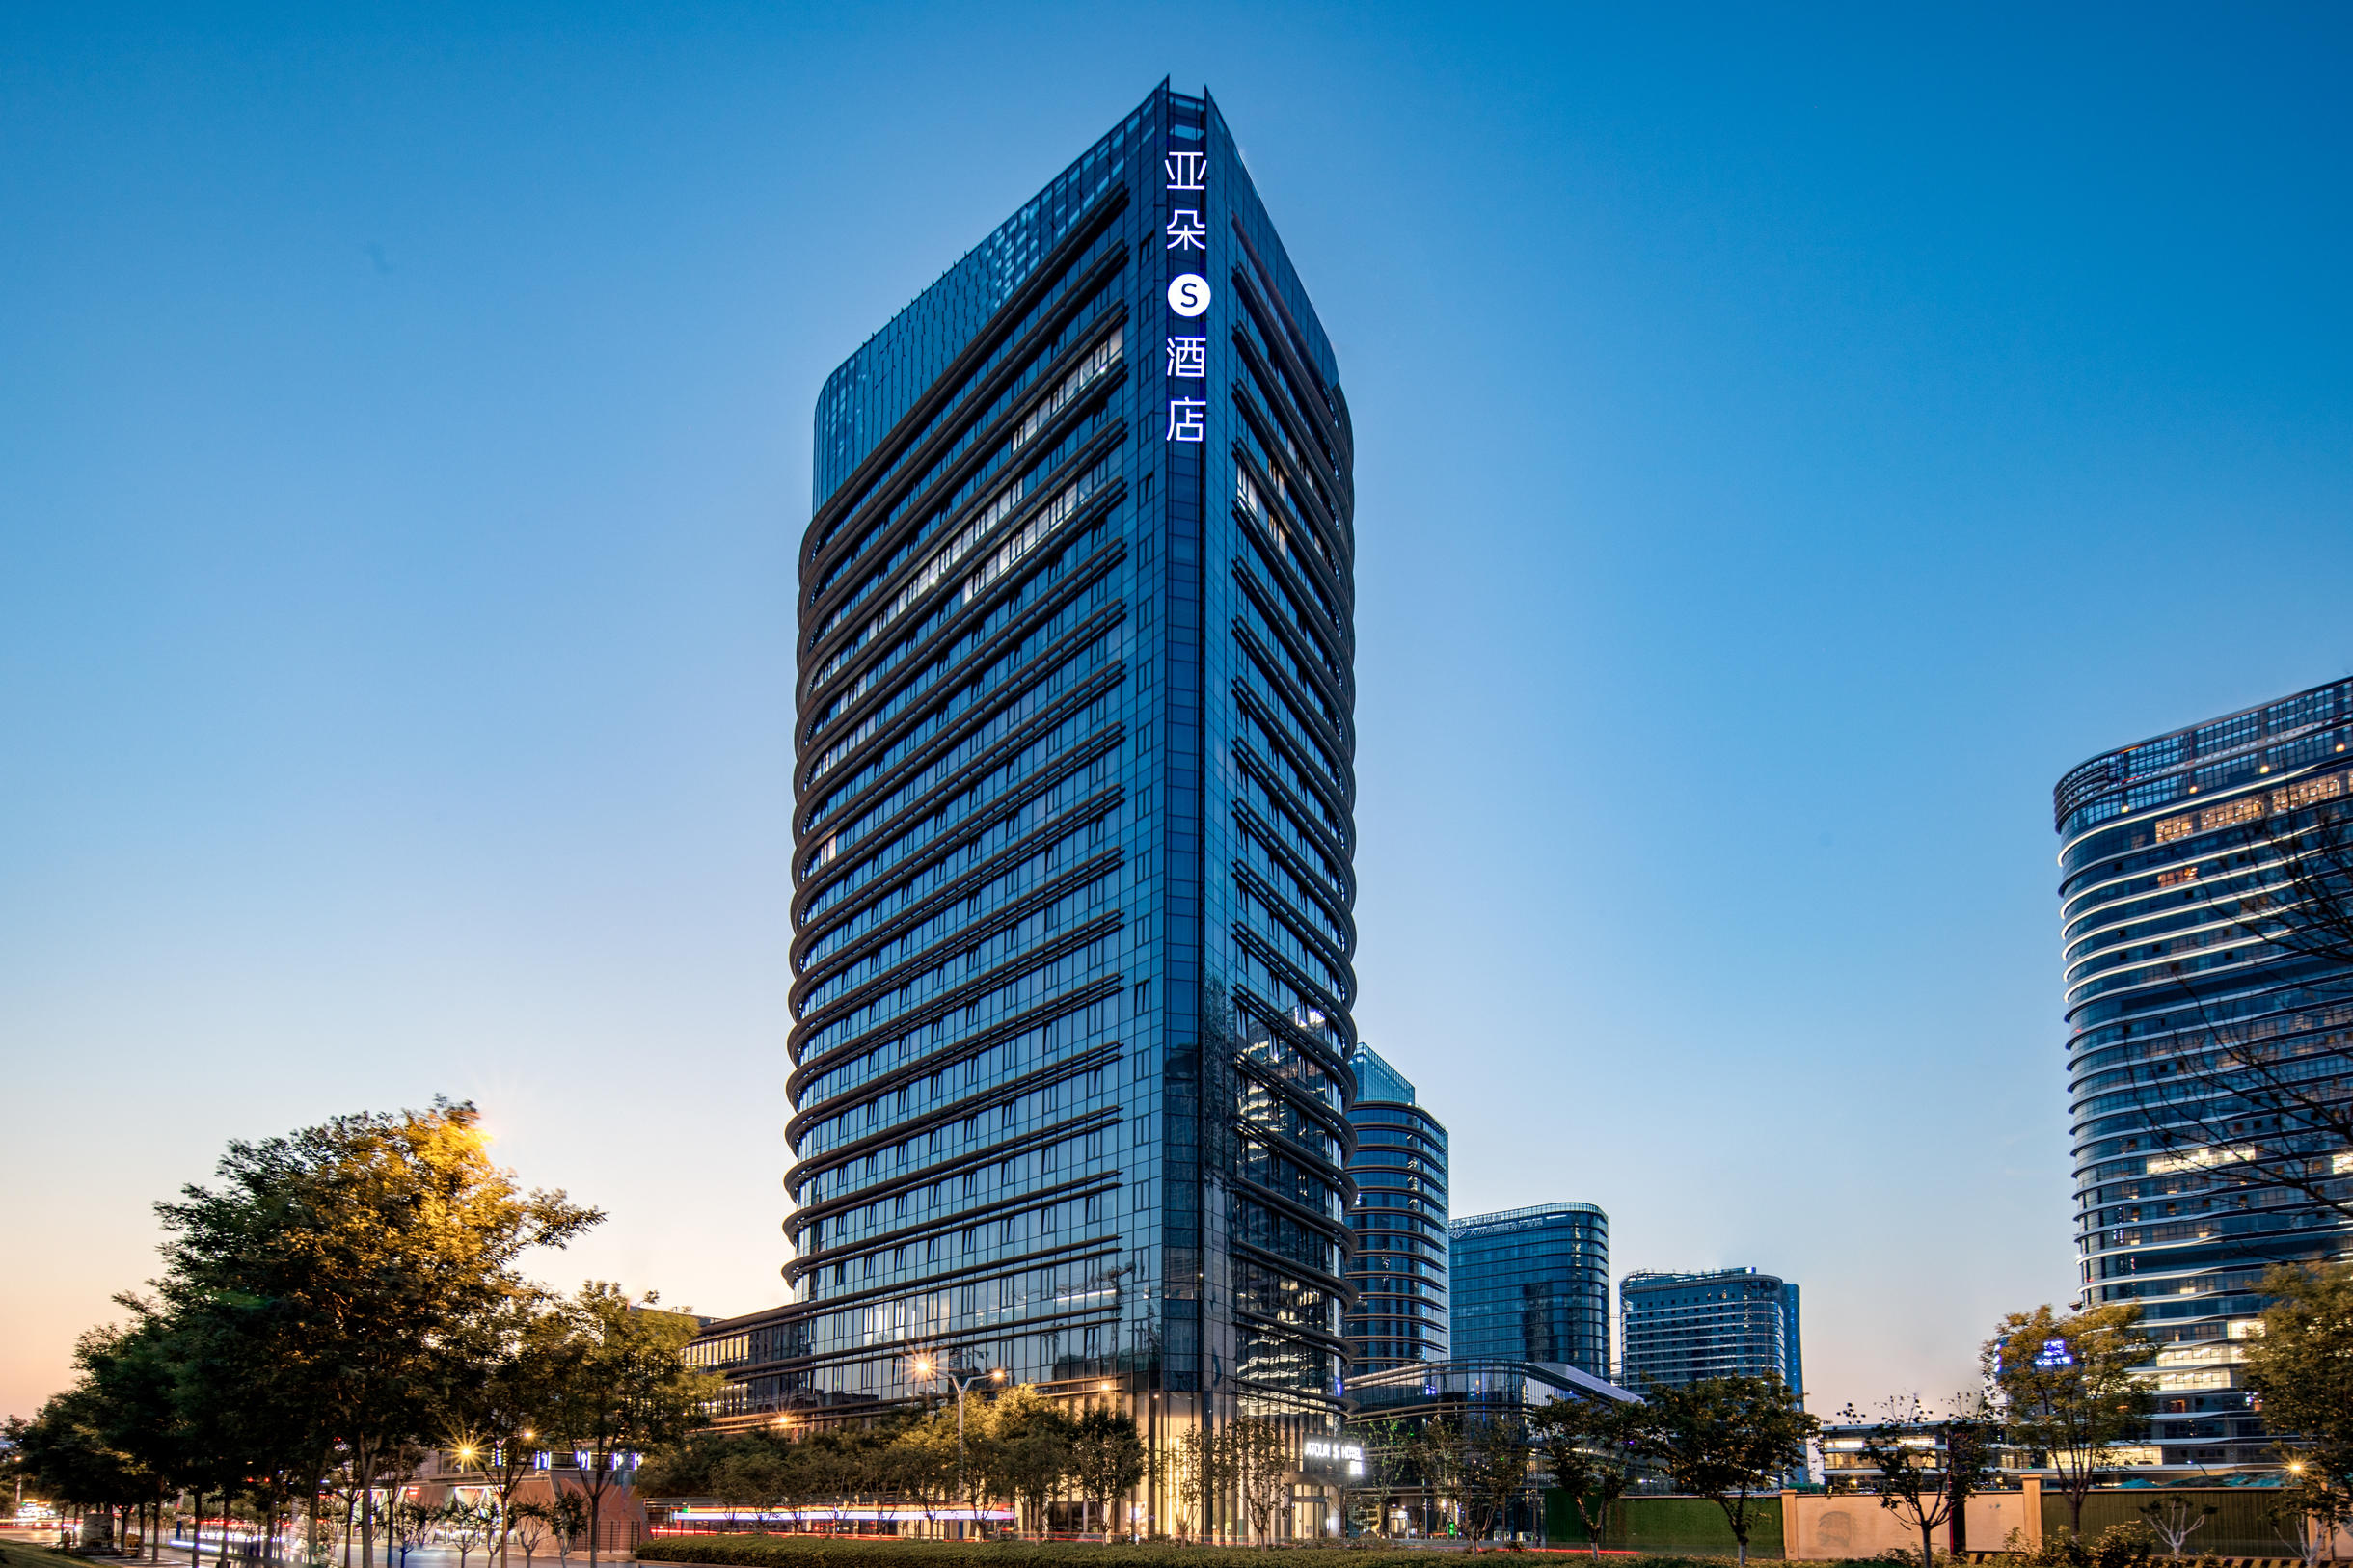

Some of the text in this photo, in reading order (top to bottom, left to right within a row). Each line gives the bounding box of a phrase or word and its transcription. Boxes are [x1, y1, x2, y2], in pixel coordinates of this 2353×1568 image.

[1305, 1443, 1363, 1460] ATOUR S HOTEL
